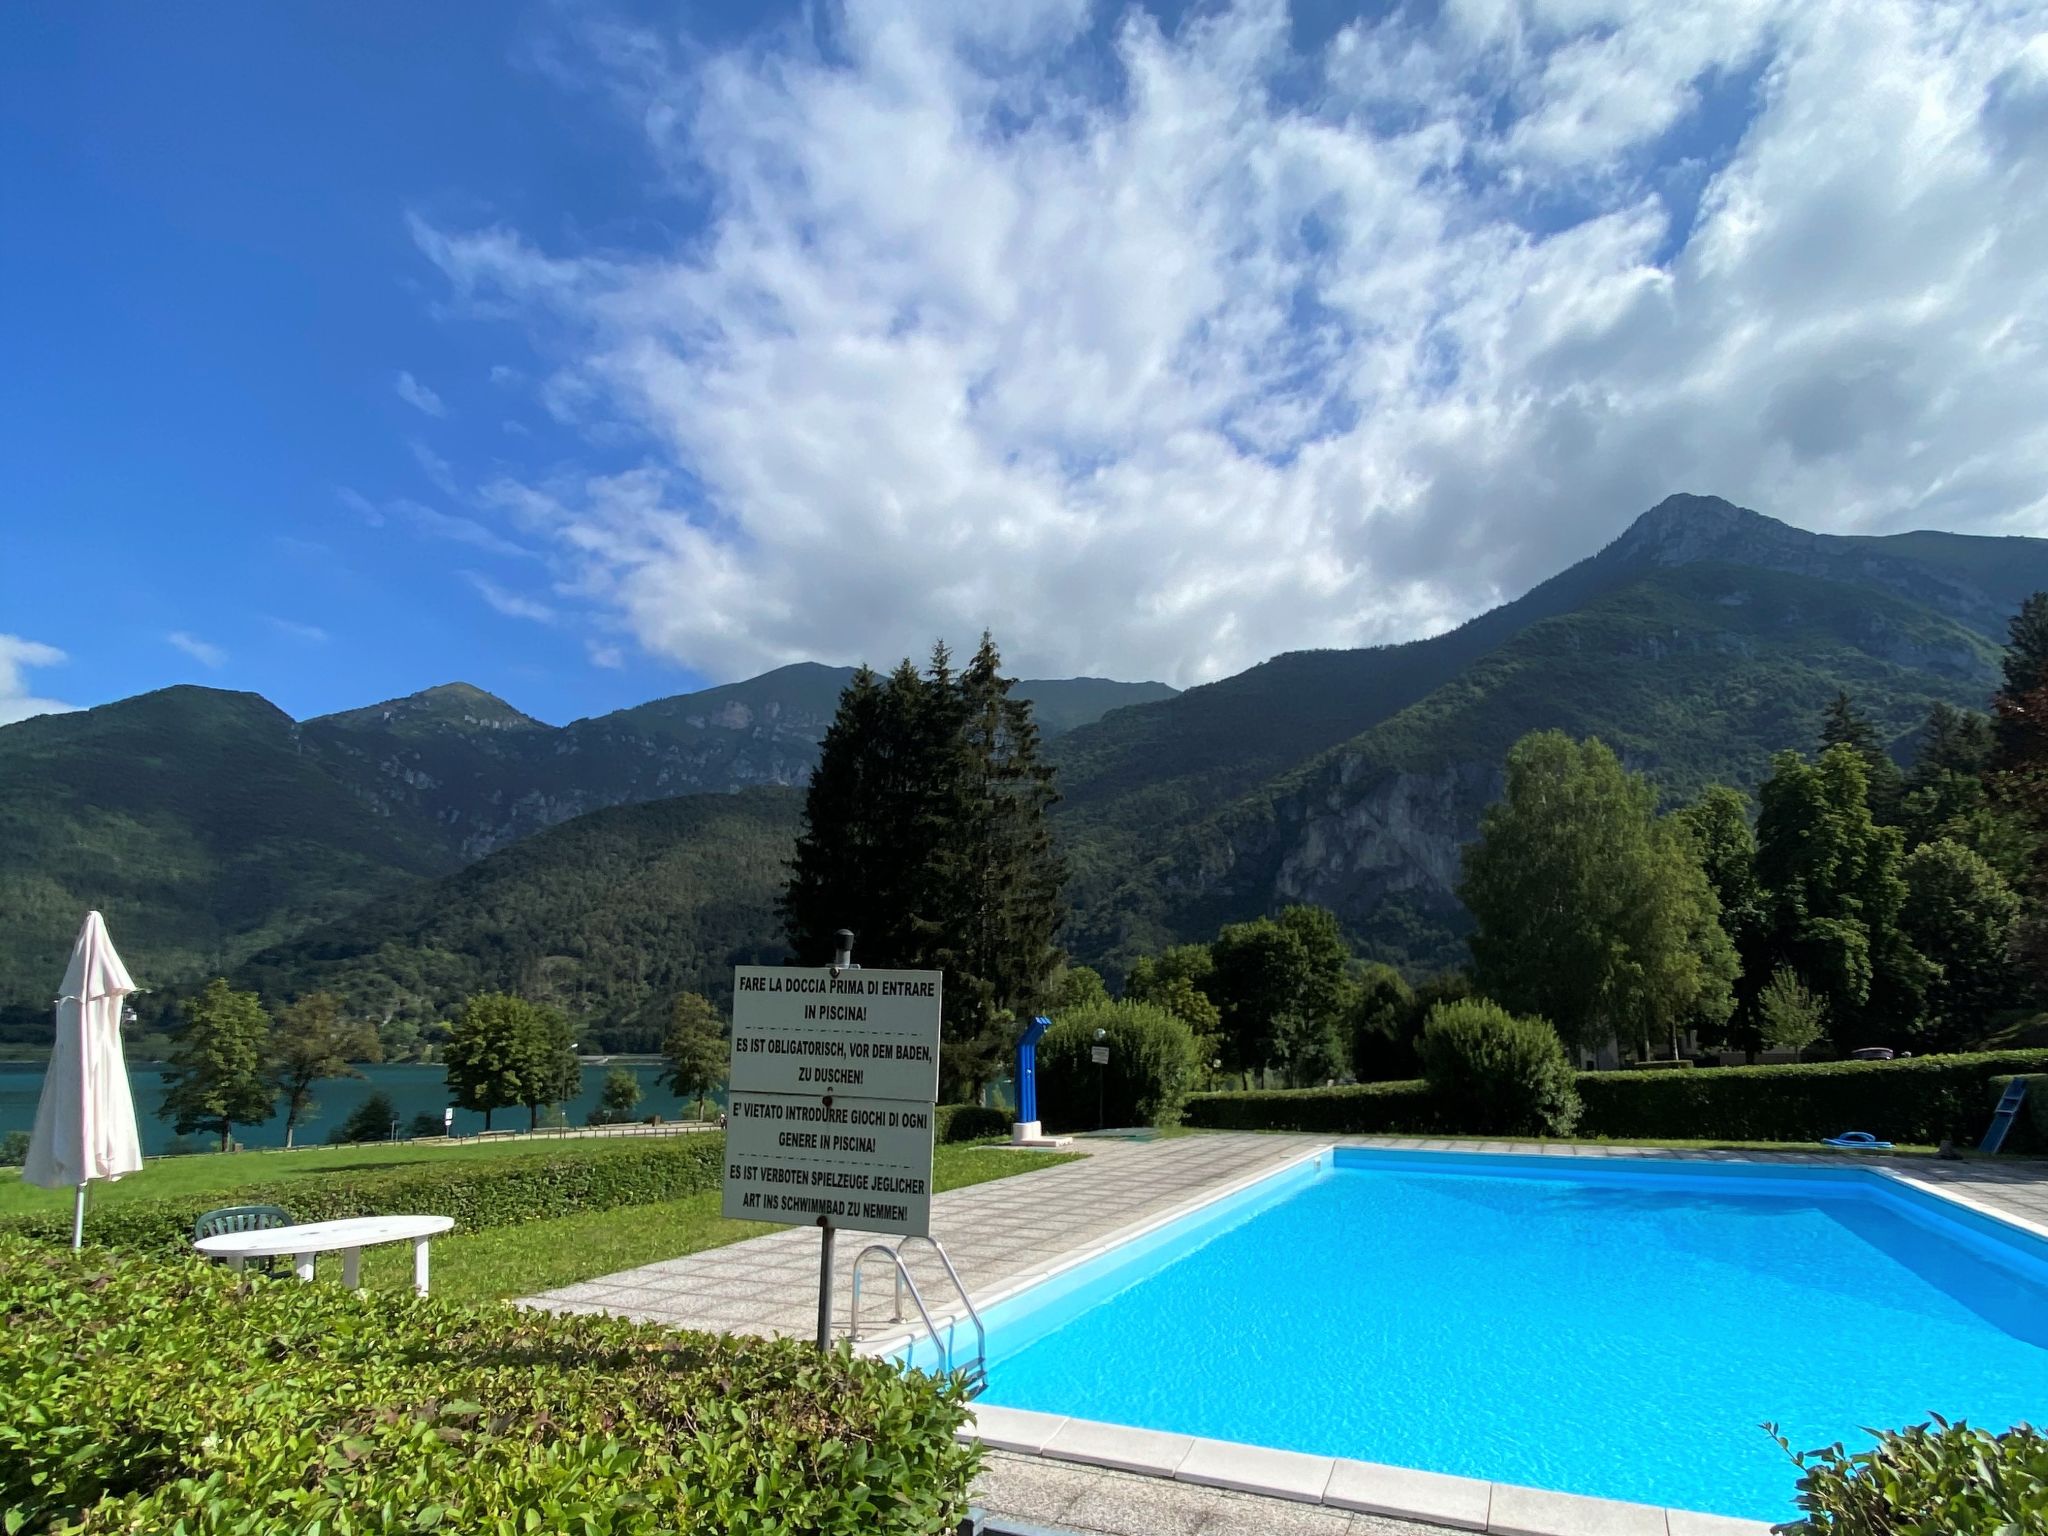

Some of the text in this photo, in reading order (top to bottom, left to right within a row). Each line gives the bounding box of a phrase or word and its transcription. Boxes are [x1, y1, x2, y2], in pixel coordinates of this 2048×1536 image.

[740, 977, 935, 997] FARE LA DOCCIA PRIMA DI ENTRARE
[804, 1005, 867, 1021] IN PISCINA!
[736, 1038, 932, 1064] ES IST OBLIGATORISCH, VOR DEM BADEN,
[798, 1067, 863, 1084] ZU DUSCHEN!
[733, 1102, 927, 1129] E' VIETATO INTRODURRE GIOCHI DI OGNI
[778, 1132, 876, 1153] GENERE IN PISCINA!
[730, 1164, 925, 1194] ES IST VERBOTEN SPIELZEUGE JEGLICHER
[743, 1192, 761, 1207] ART
[763, 1193, 779, 1209] INS
[781, 1195, 845, 1215] SCHWIMMBAD
[847, 1201, 860, 1217] ZU
